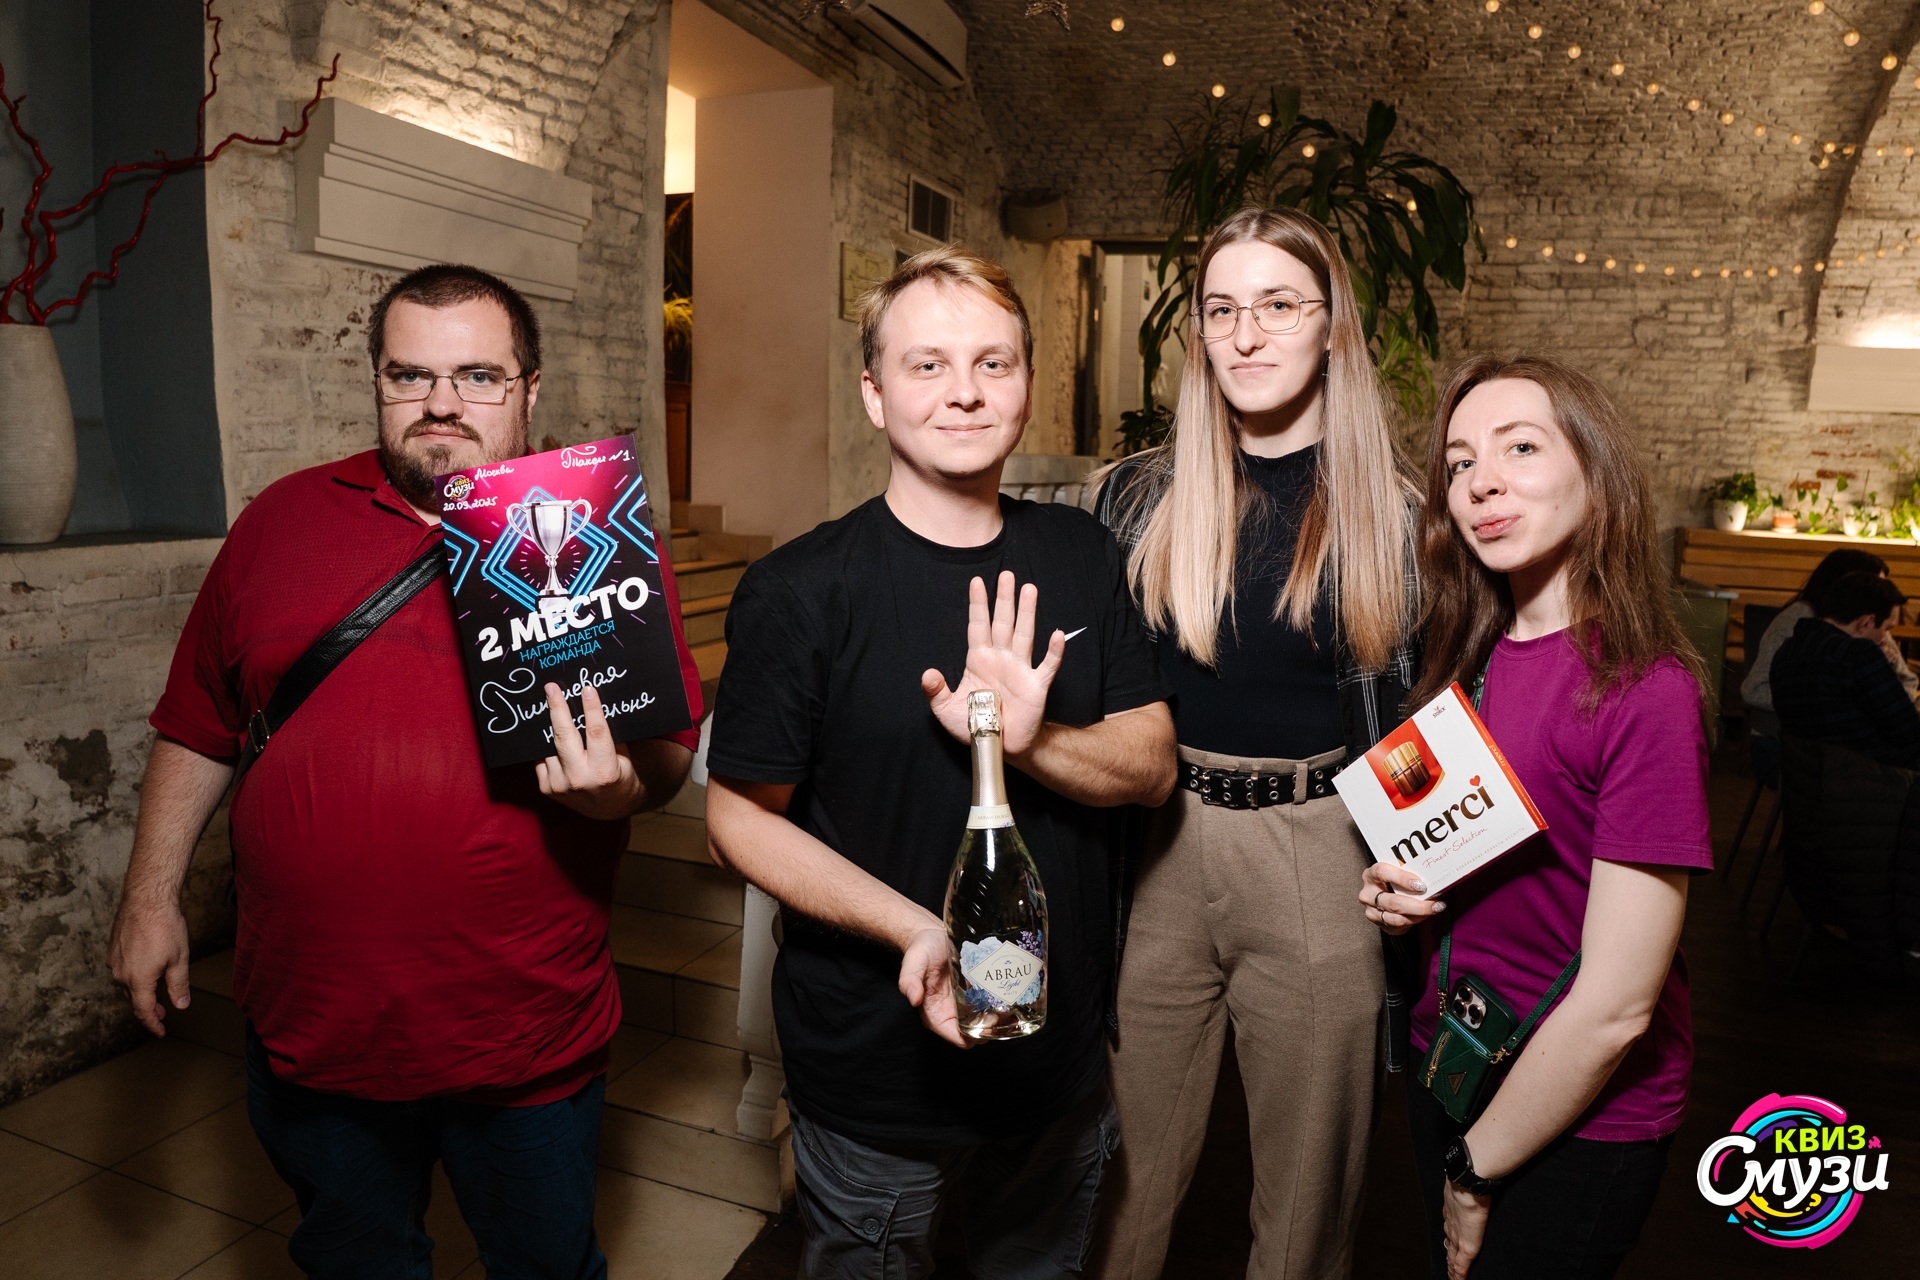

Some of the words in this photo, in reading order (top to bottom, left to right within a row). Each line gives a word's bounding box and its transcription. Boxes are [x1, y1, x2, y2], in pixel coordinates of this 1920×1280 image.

[474, 464, 514, 481] Москва
[443, 482, 475, 498] Смузи
[478, 626, 504, 662] 2
[510, 576, 649, 651] МЕСТО
[519, 619, 616, 662] НАГРАЖДАЕТСЯ
[539, 639, 602, 669] КОМАНДА
[1390, 775, 1495, 866] merci
[1422, 847, 1451, 869] Finest
[1452, 828, 1488, 852] Selection
[984, 964, 1032, 981] ABRAU
[997, 978, 1022, 992] Light
